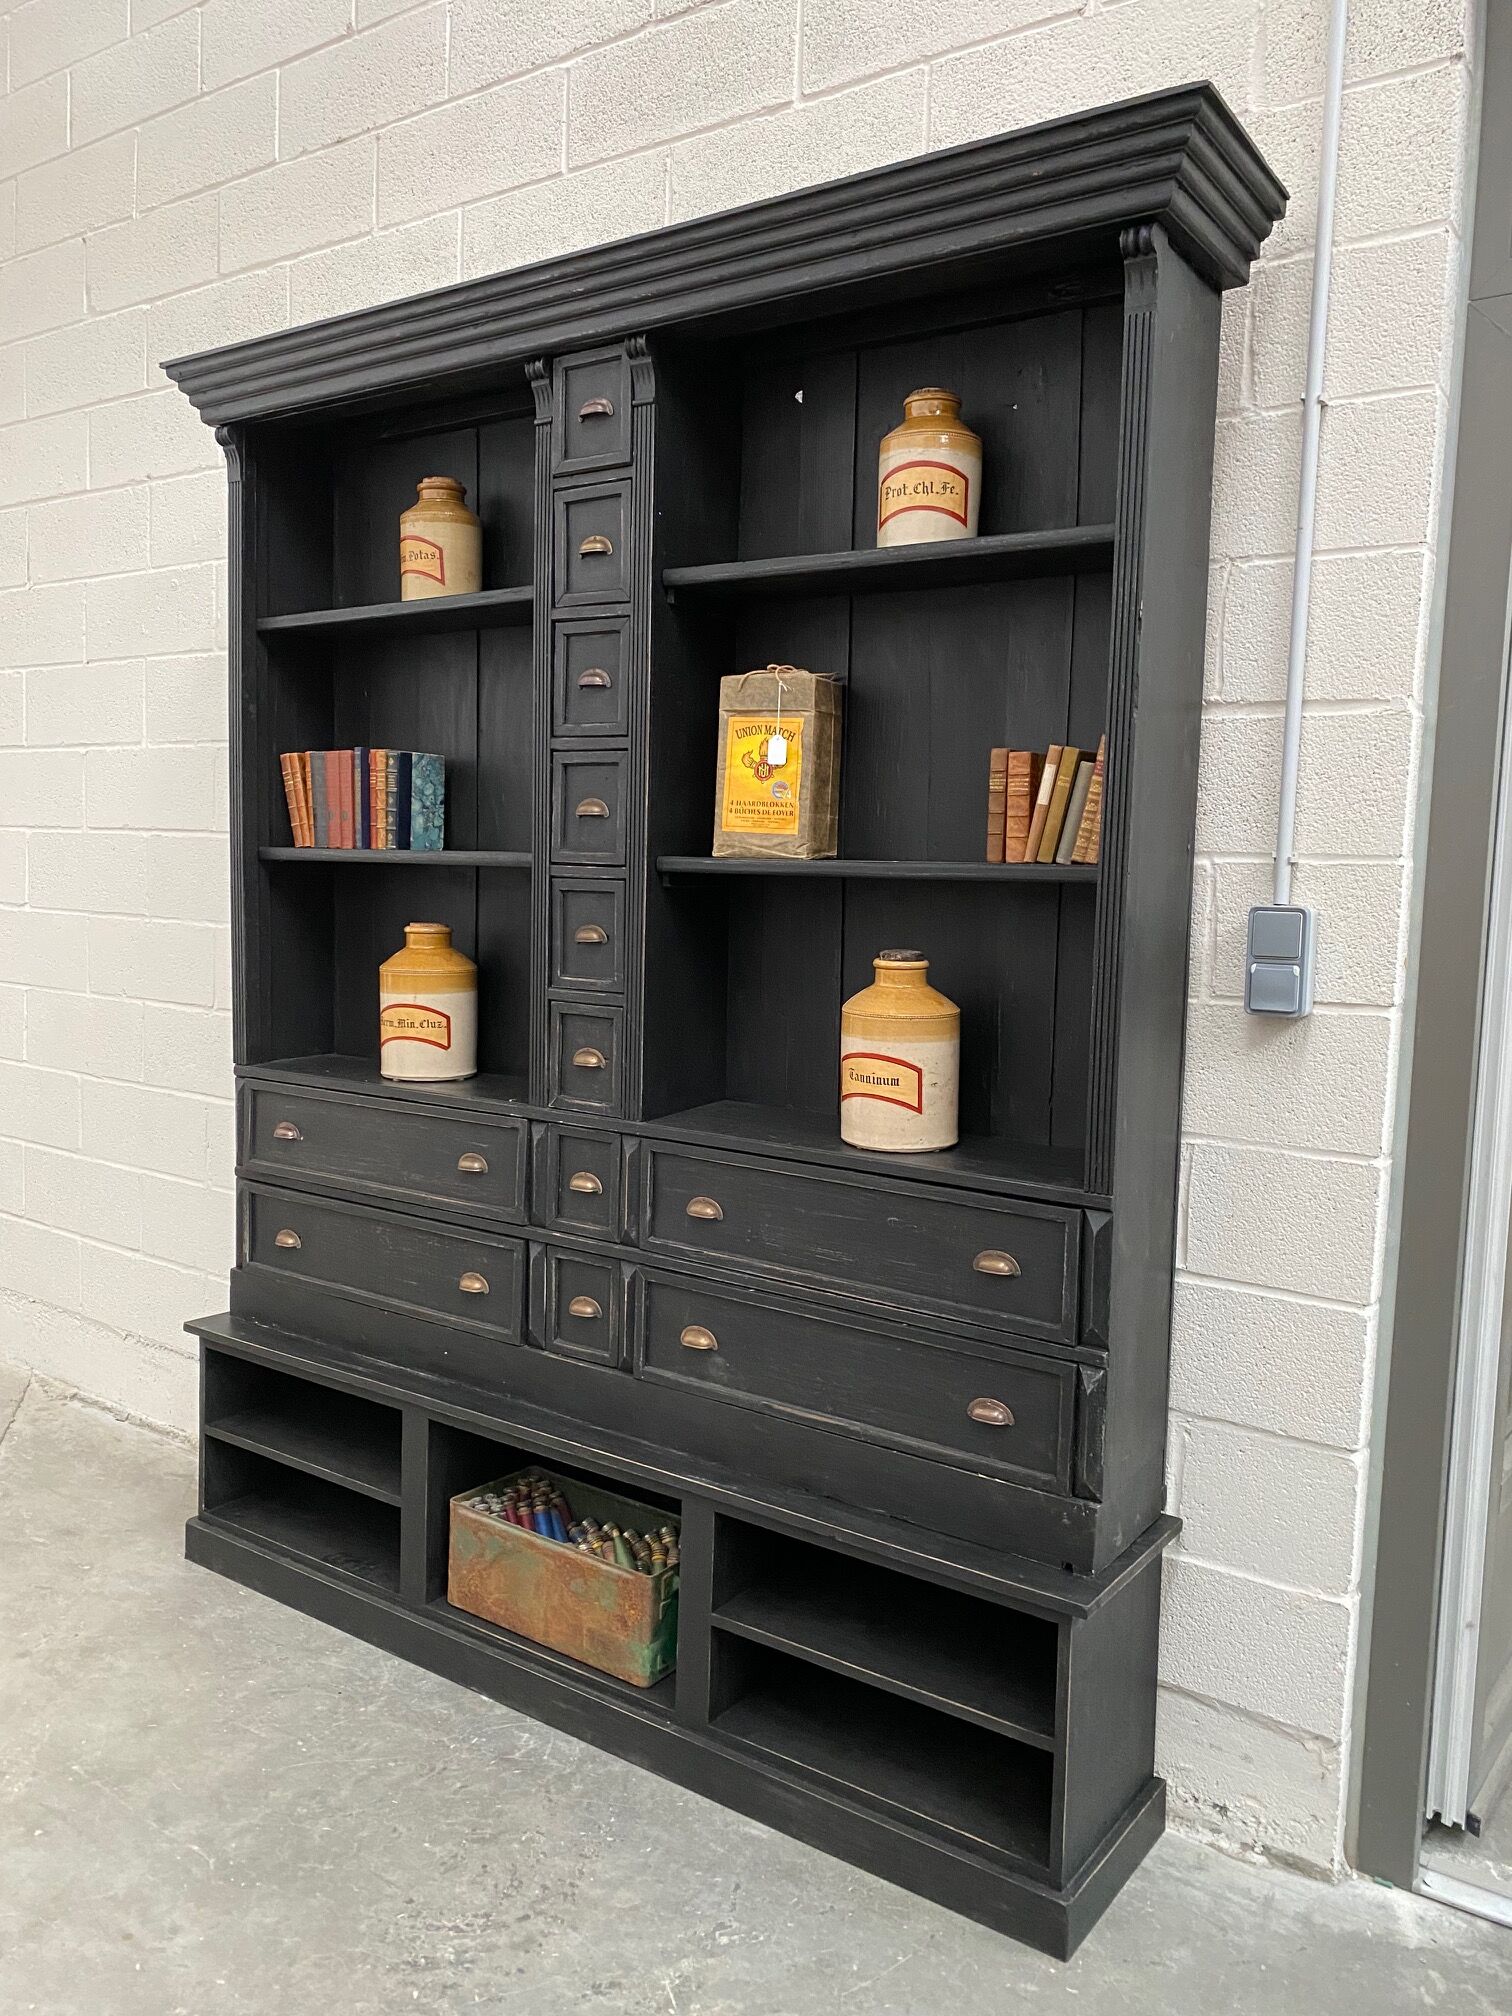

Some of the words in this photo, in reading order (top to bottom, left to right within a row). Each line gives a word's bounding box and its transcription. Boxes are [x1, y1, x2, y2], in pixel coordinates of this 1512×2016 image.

[735, 724, 763, 739] UNION
[764, 724, 796, 742] MATCH
[848, 1067, 900, 1087] Tanninum
